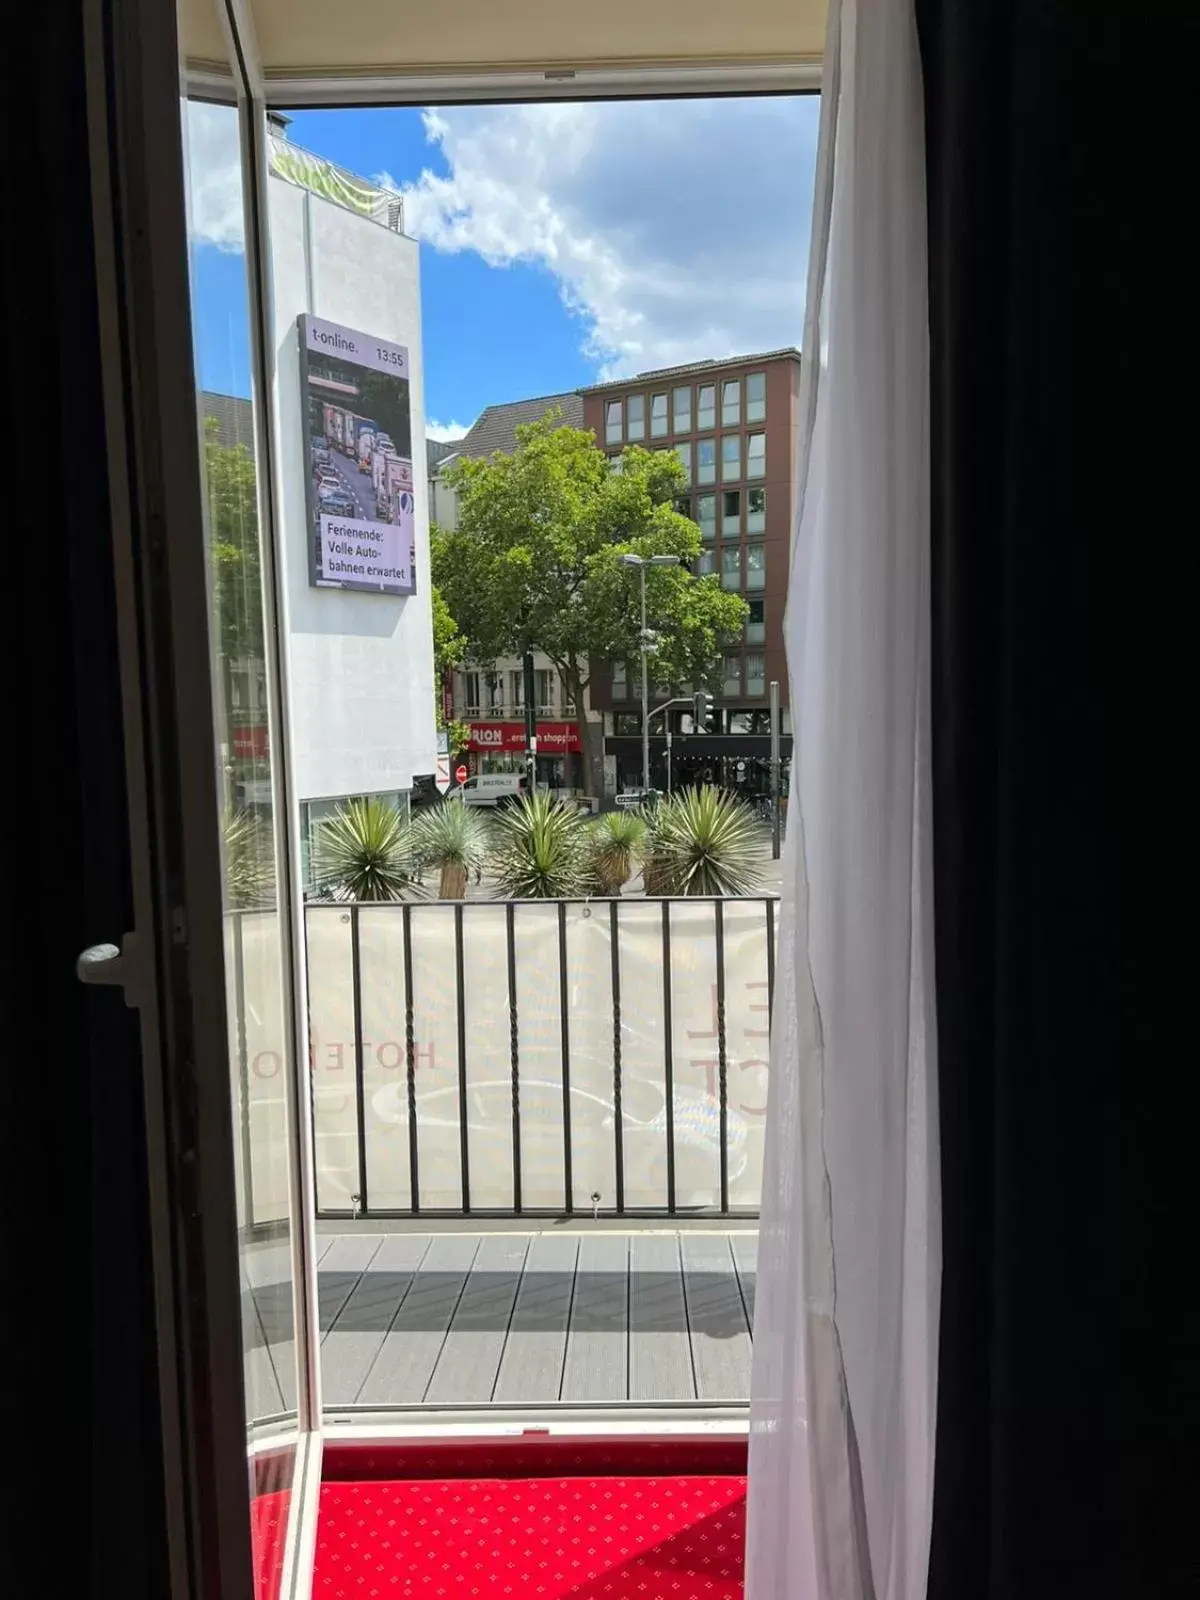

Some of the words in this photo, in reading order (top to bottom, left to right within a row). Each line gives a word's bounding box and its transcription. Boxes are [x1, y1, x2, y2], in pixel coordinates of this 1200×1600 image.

[312, 329, 359, 353] t-online.
[376, 348, 404, 367] 13:55
[327, 522, 384, 542] Ferienende:
[327, 540, 354, 555] Volle
[354, 545, 382, 558] Auto-
[329, 558, 365, 575] bahnen
[366, 566, 405, 579] erwartet
